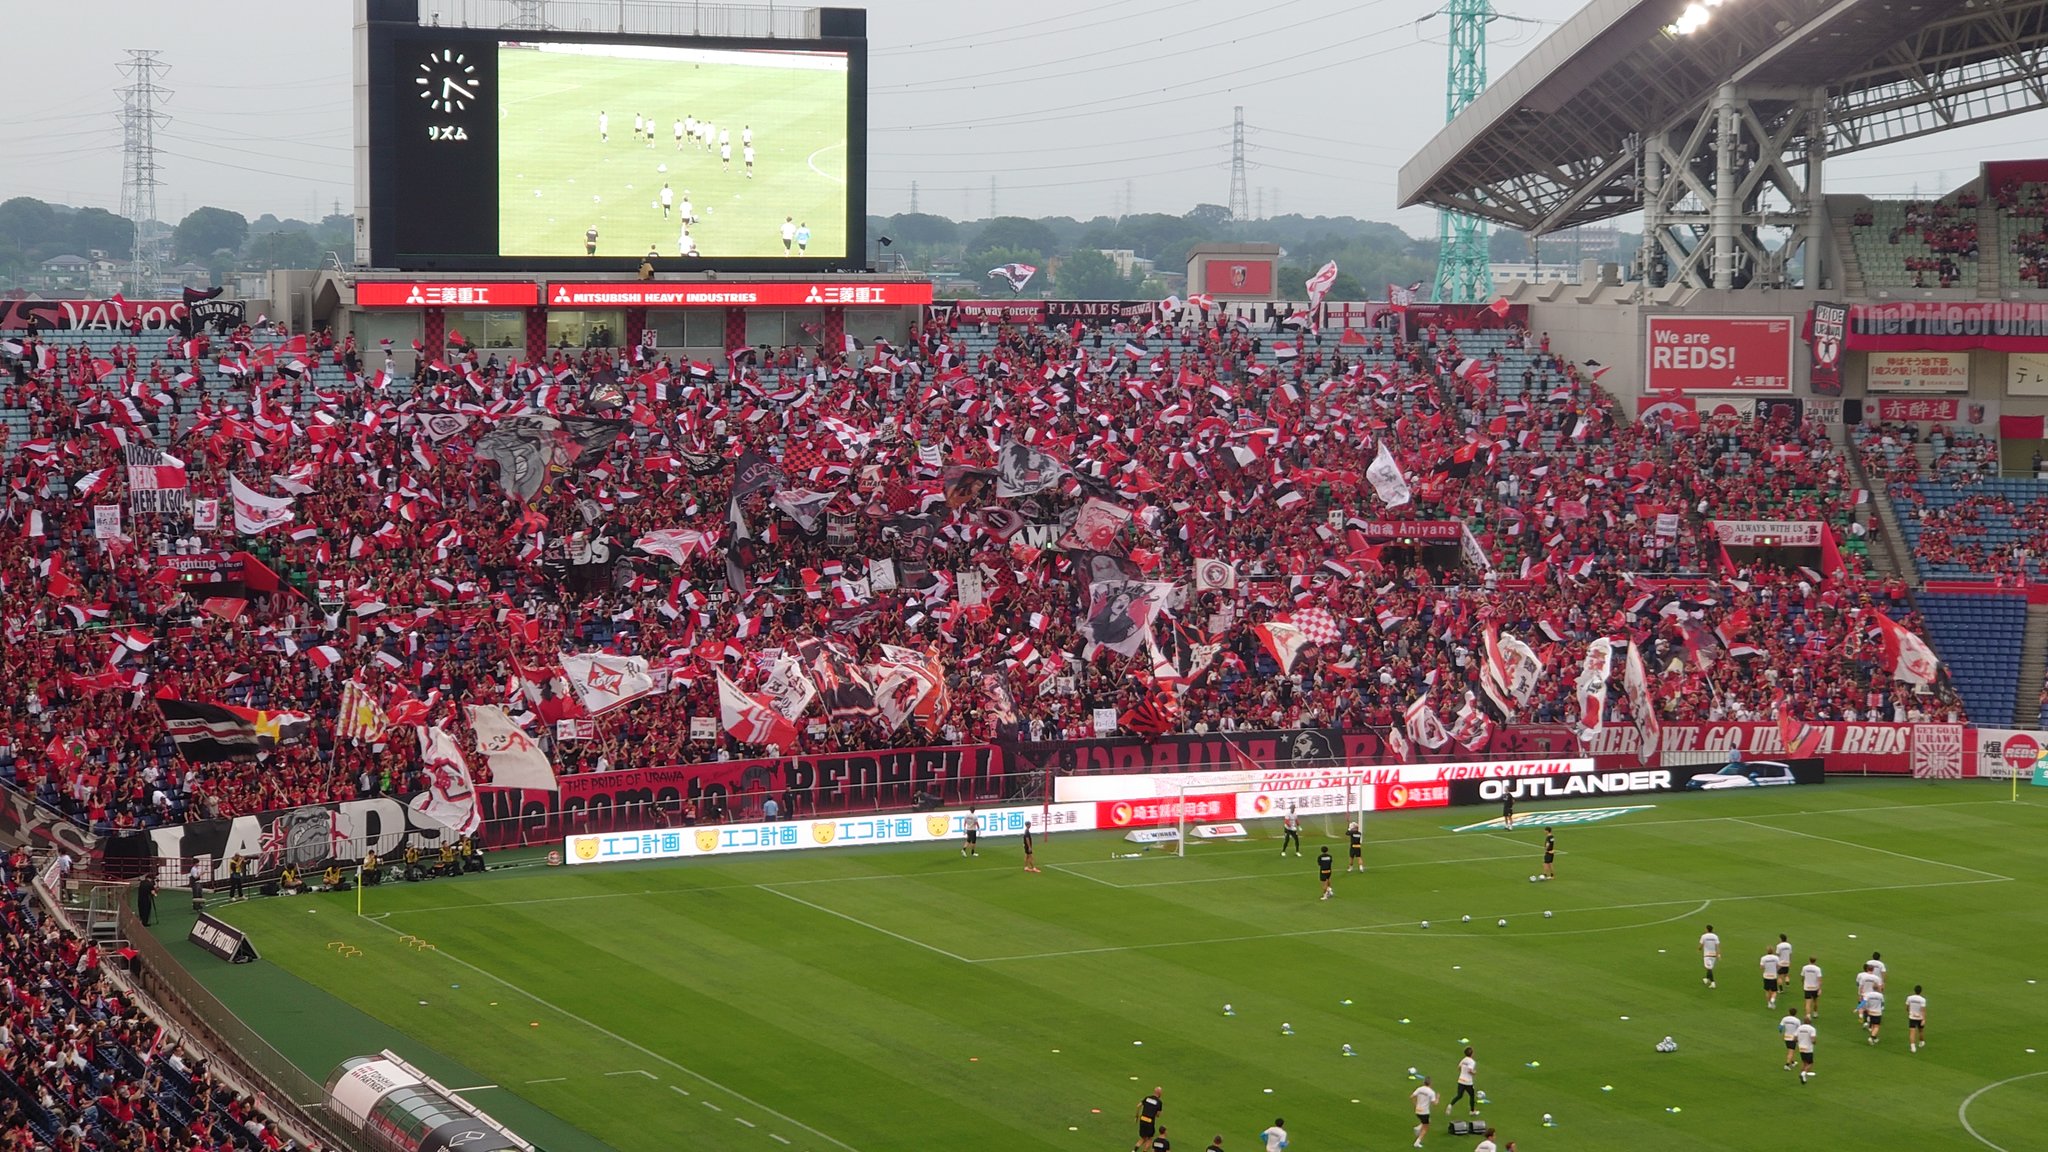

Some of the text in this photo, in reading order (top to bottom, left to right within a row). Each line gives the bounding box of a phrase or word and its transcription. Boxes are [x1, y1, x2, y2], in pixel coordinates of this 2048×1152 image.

[428, 126, 468, 141] リズム
[426, 287, 489, 304] 三菱重工
[574, 292, 757, 303] MITSUBISHI HEAVY INDUSTRIES
[824, 287, 885, 303] 三菱重工
[195, 302, 240, 318] URAWA
[1049, 302, 1121, 316] FLAMES
[1655, 330, 1710, 344] We are
[1653, 346, 1736, 370] REDS!
[1744, 376, 1786, 387] 三菱重工
[1884, 402, 1954, 420] 赤酔連
[197, 502, 215, 523] +3
[1735, 524, 1804, 533] ALWAYS WITH US
[167, 558, 217, 572] Fighting
[1589, 723, 1640, 752] HER
[1662, 721, 1700, 751] WE
[1705, 721, 1744, 751] GO
[1841, 722, 1910, 754] REDS
[1917, 734, 1960, 743] URAWA
[2005, 748, 2037, 758] REDS
[564, 770, 686, 792] THE PRIDE OF URAWA
[1479, 769, 1672, 800] OUTLANDER
[722, 825, 798, 848] エコ計画
[838, 817, 912, 840] エコ計画
[602, 832, 681, 856] エコ計画
